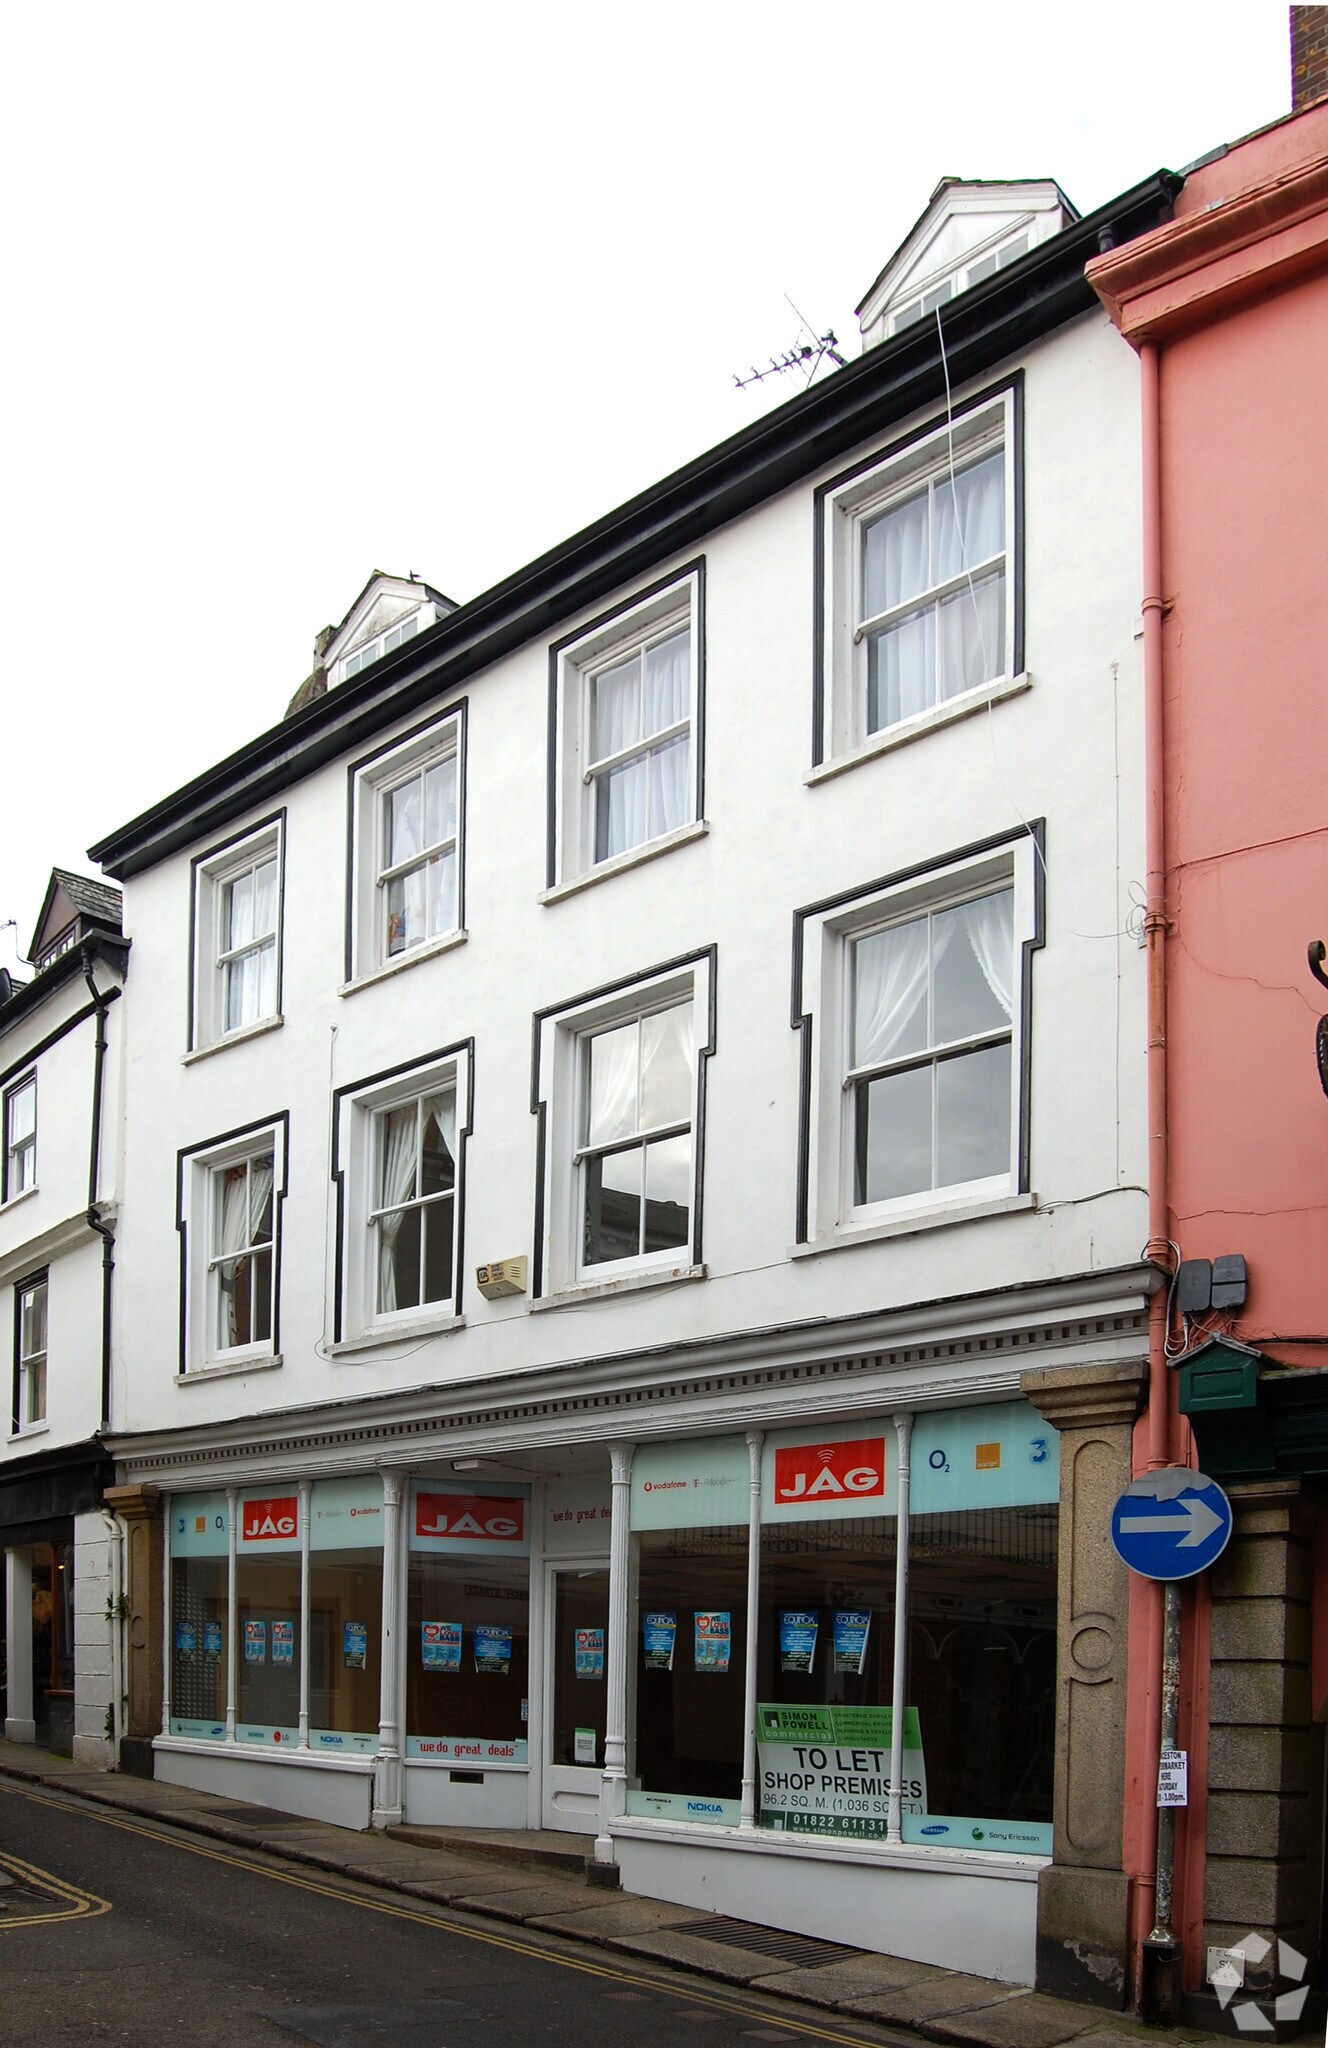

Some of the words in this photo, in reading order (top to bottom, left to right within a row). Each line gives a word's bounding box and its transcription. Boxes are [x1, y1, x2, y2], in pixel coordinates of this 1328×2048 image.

[653, 1481, 687, 1490] vodafone
[780, 1466, 879, 1497] JAG
[564, 1509, 573, 1520] do
[576, 1507, 596, 1523] great
[245, 1515, 295, 1537] JAG
[421, 1512, 519, 1536] JAG
[783, 1615, 815, 1624] EQUINOX
[836, 1615, 869, 1624] EQUINOX
[781, 1711, 818, 1721] SIMON
[783, 1721, 829, 1730] POWELL
[320, 1735, 343, 1744] NOKIA
[766, 1730, 832, 1740] commercial
[437, 1741, 448, 1753] do
[454, 1744, 482, 1757] great
[1161, 1751, 1181, 1760] CESTON
[793, 1747, 828, 1770] TO
[835, 1749, 884, 1773] LET
[764, 1771, 815, 1791] SHOP
[821, 1775, 923, 1799] PREMISES
[687, 1802, 723, 1813] NOKIA
[763, 1793, 787, 1806] 96.2
[790, 1795, 812, 1808] SQ.
[815, 1797, 829, 1809] M.
[832, 1797, 869, 1812] (1,036
[793, 1814, 834, 1827] 01822
[842, 1817, 885, 1831] 61131
[792, 1826, 887, 1841] www.simonpowell.co.u
[988, 1832, 1007, 1840] Sony
[1008, 1833, 1040, 1842] Ericsson
